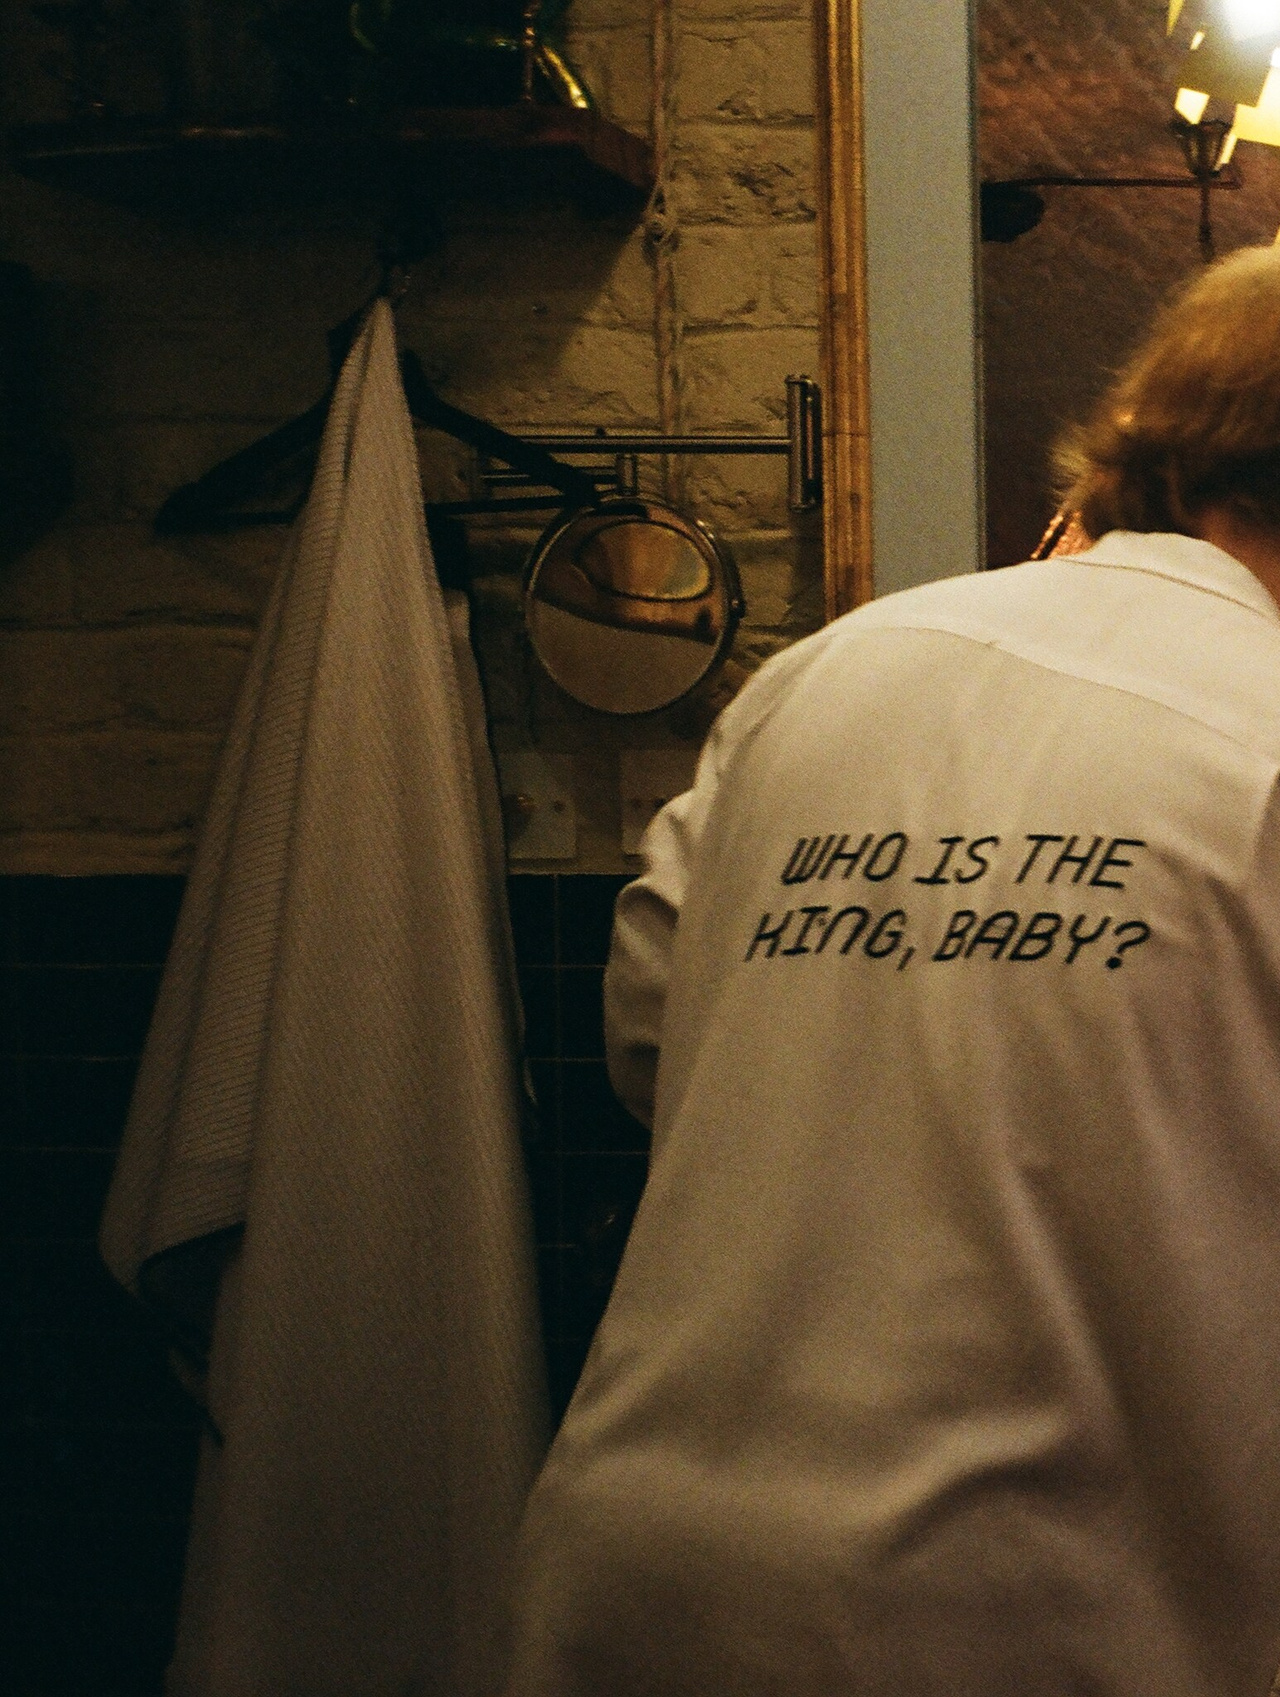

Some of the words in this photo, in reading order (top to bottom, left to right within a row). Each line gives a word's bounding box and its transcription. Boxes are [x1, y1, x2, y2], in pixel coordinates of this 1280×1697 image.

[780, 831, 909, 886] WHO
[912, 835, 1000, 886] IS
[1014, 832, 1148, 889] THE
[743, 905, 916, 971] KING,
[931, 909, 1151, 970] BABY?
